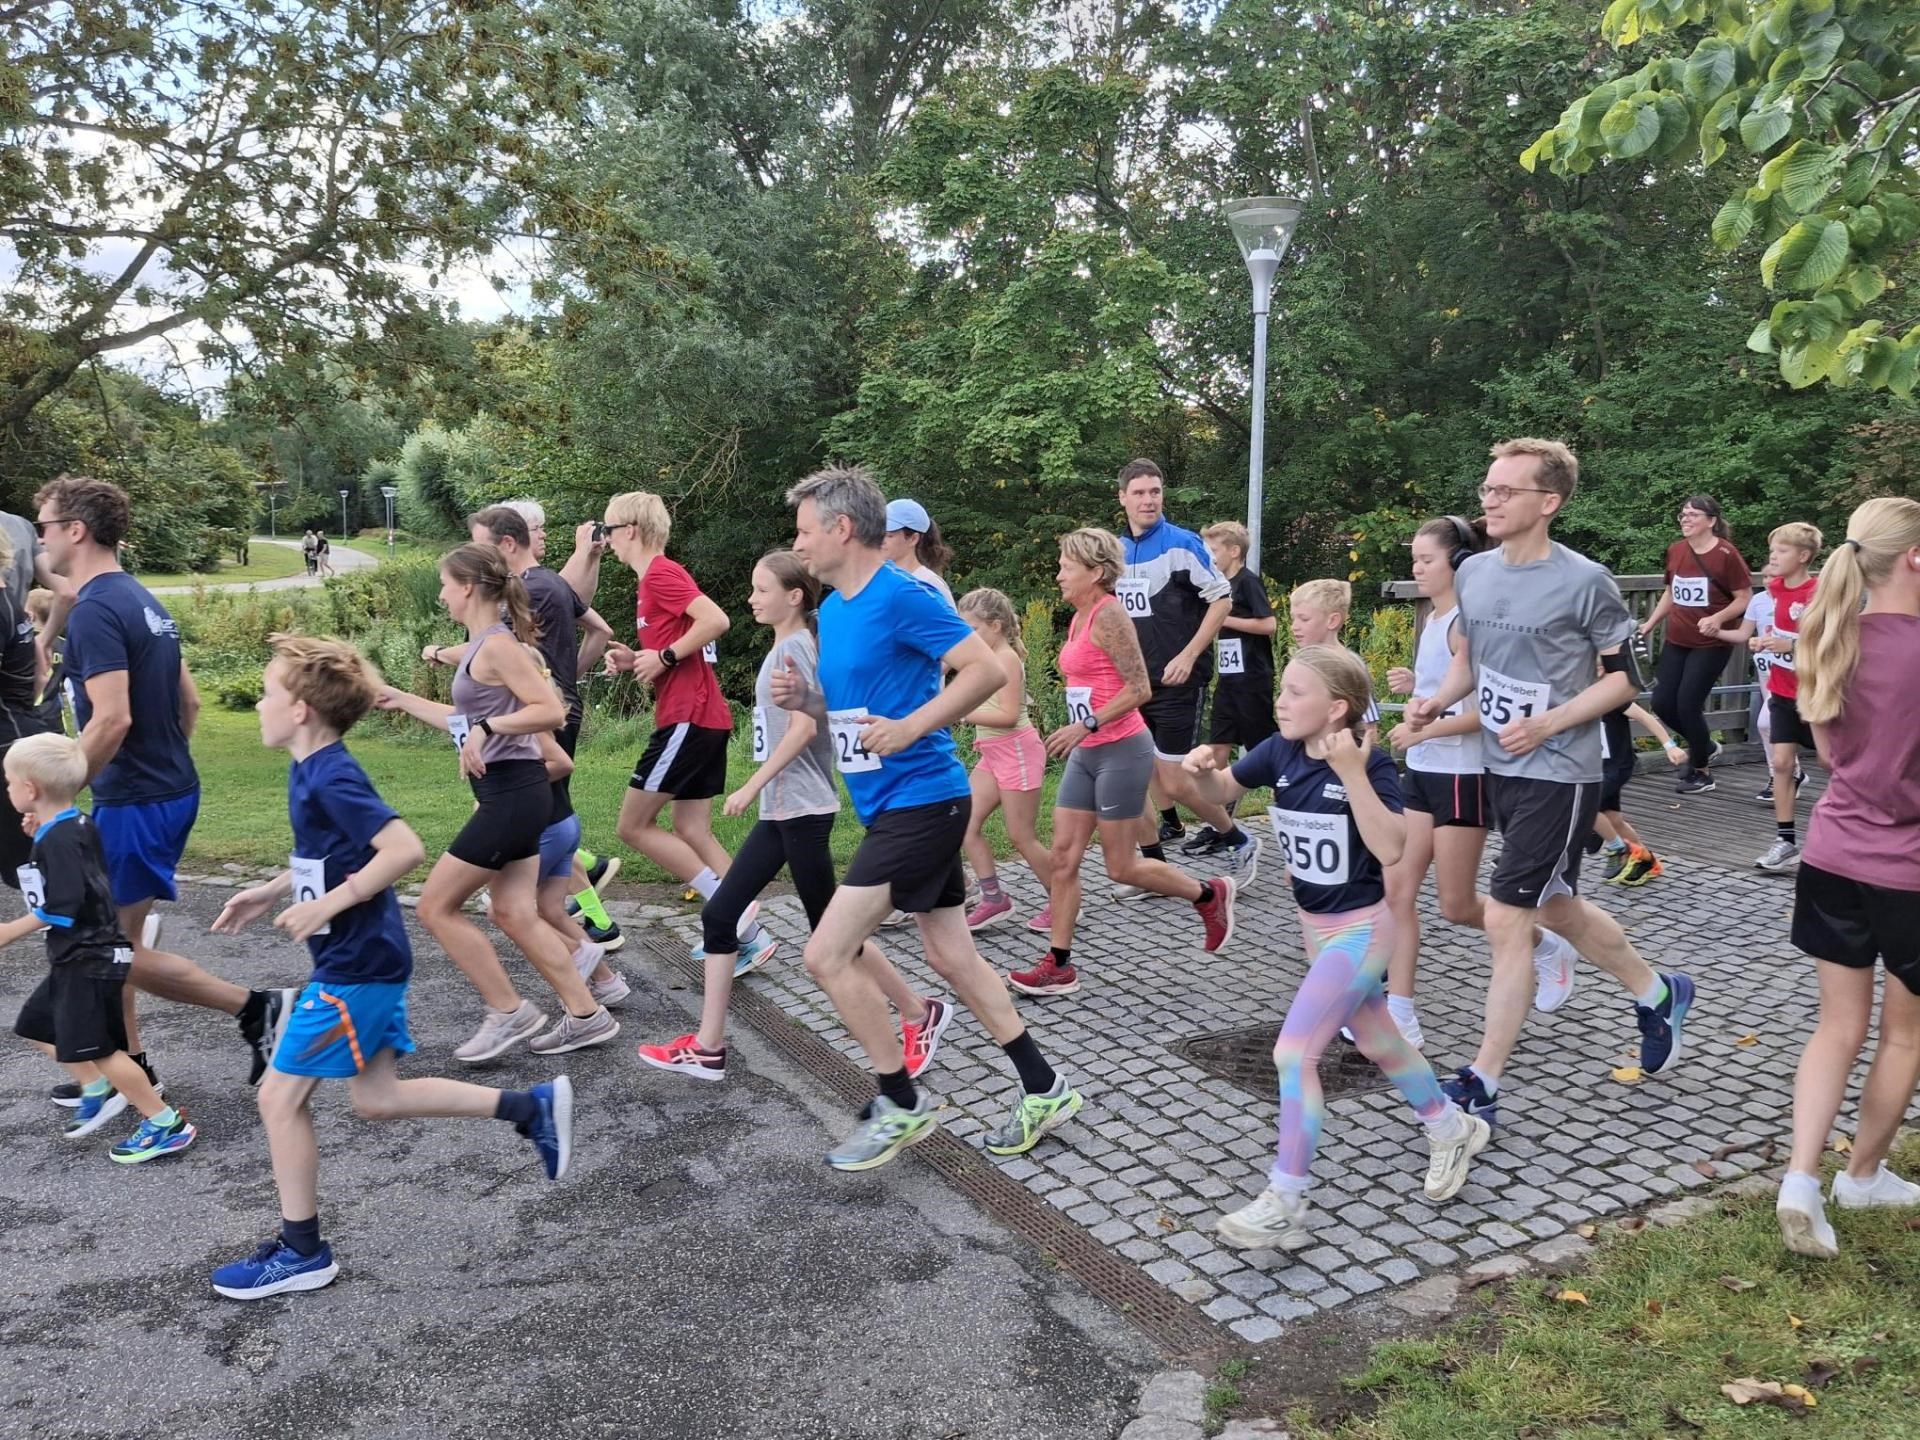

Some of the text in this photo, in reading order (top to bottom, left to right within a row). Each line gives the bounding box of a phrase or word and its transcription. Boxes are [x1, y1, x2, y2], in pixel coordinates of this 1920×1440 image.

[1117, 592, 1146, 611] 760
[1674, 586, 1705, 602] 802
[1219, 651, 1240, 668] 854
[1480, 686, 1534, 725] 851
[1278, 830, 1340, 874] 850
